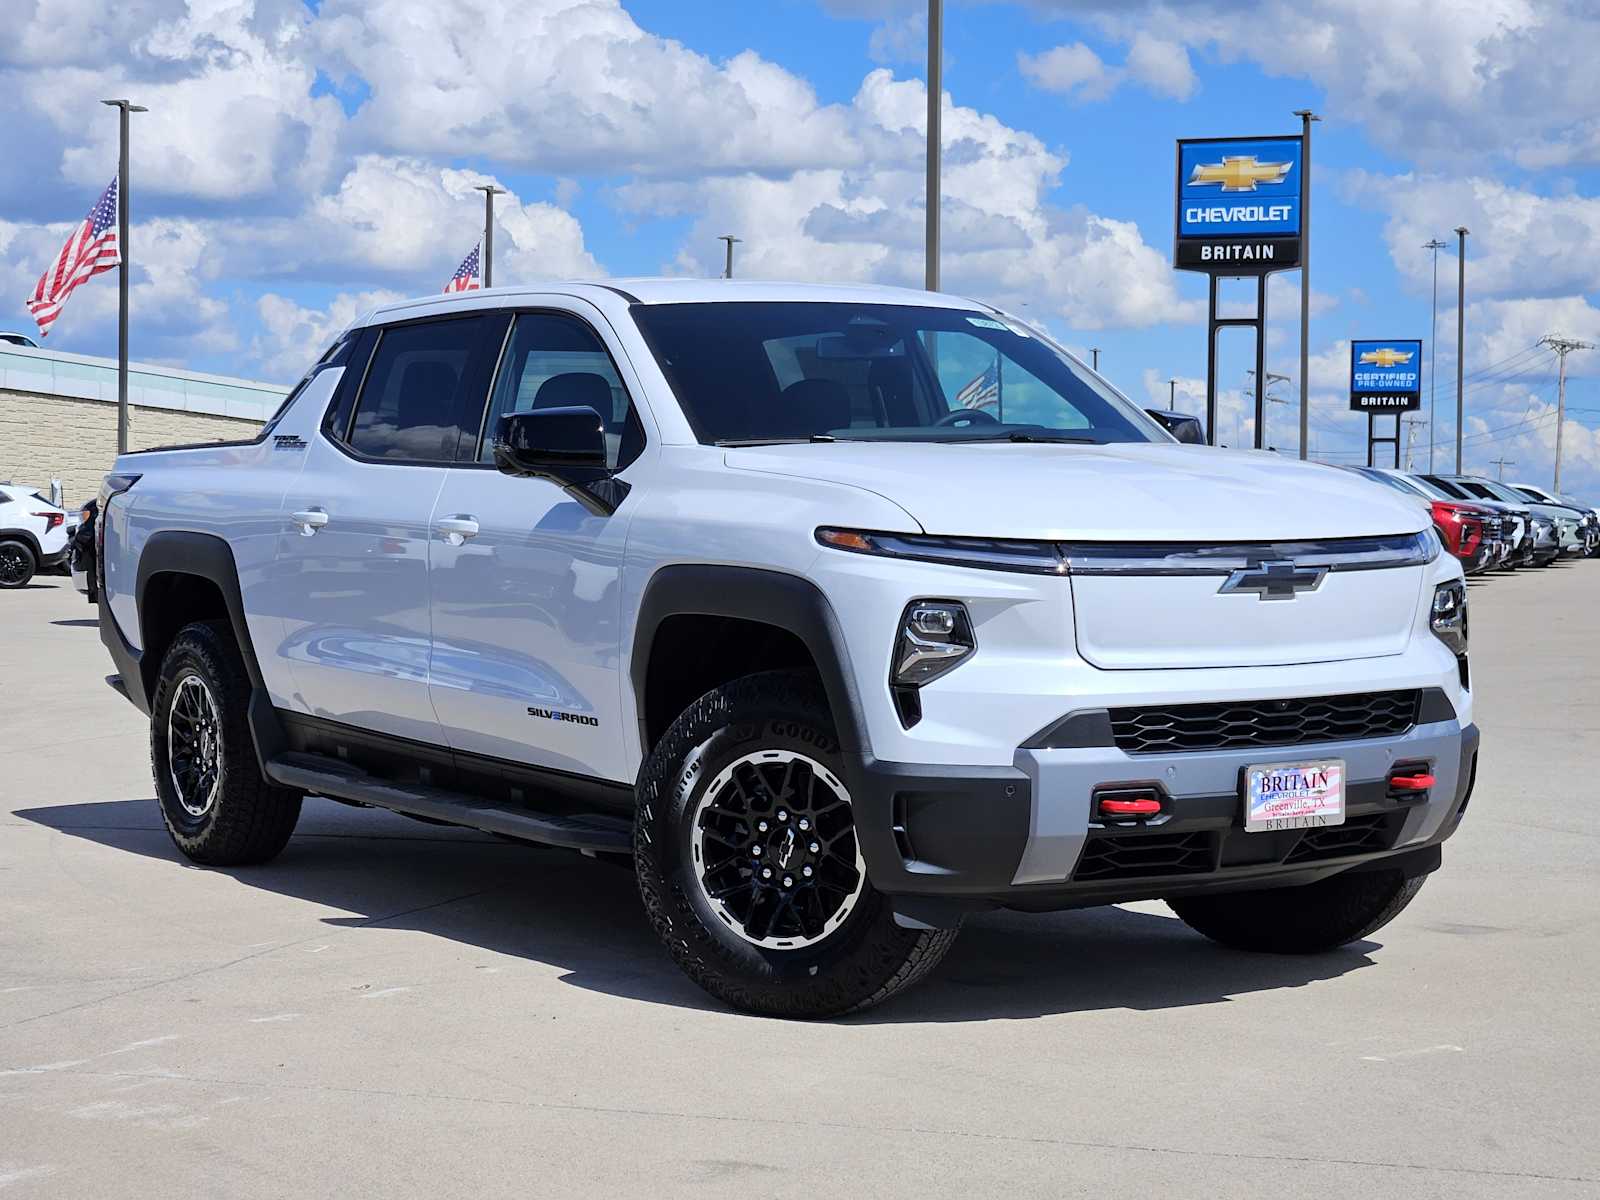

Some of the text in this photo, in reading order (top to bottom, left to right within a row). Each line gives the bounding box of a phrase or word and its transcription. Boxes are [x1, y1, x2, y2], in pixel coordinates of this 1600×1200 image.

[1186, 205, 1292, 223] CHEVROLET
[1200, 244, 1275, 261] BRITAIN
[1355, 373, 1416, 381] CERTIFIED
[1360, 396, 1409, 406] BRITAIN
[527, 706, 599, 727] SILVERADO
[1261, 772, 1328, 793] BRITAIN
[1260, 789, 1310, 801] CHEVROLET
[1313, 796, 1326, 808] TX
[1266, 816, 1327, 829] BRITAIN
